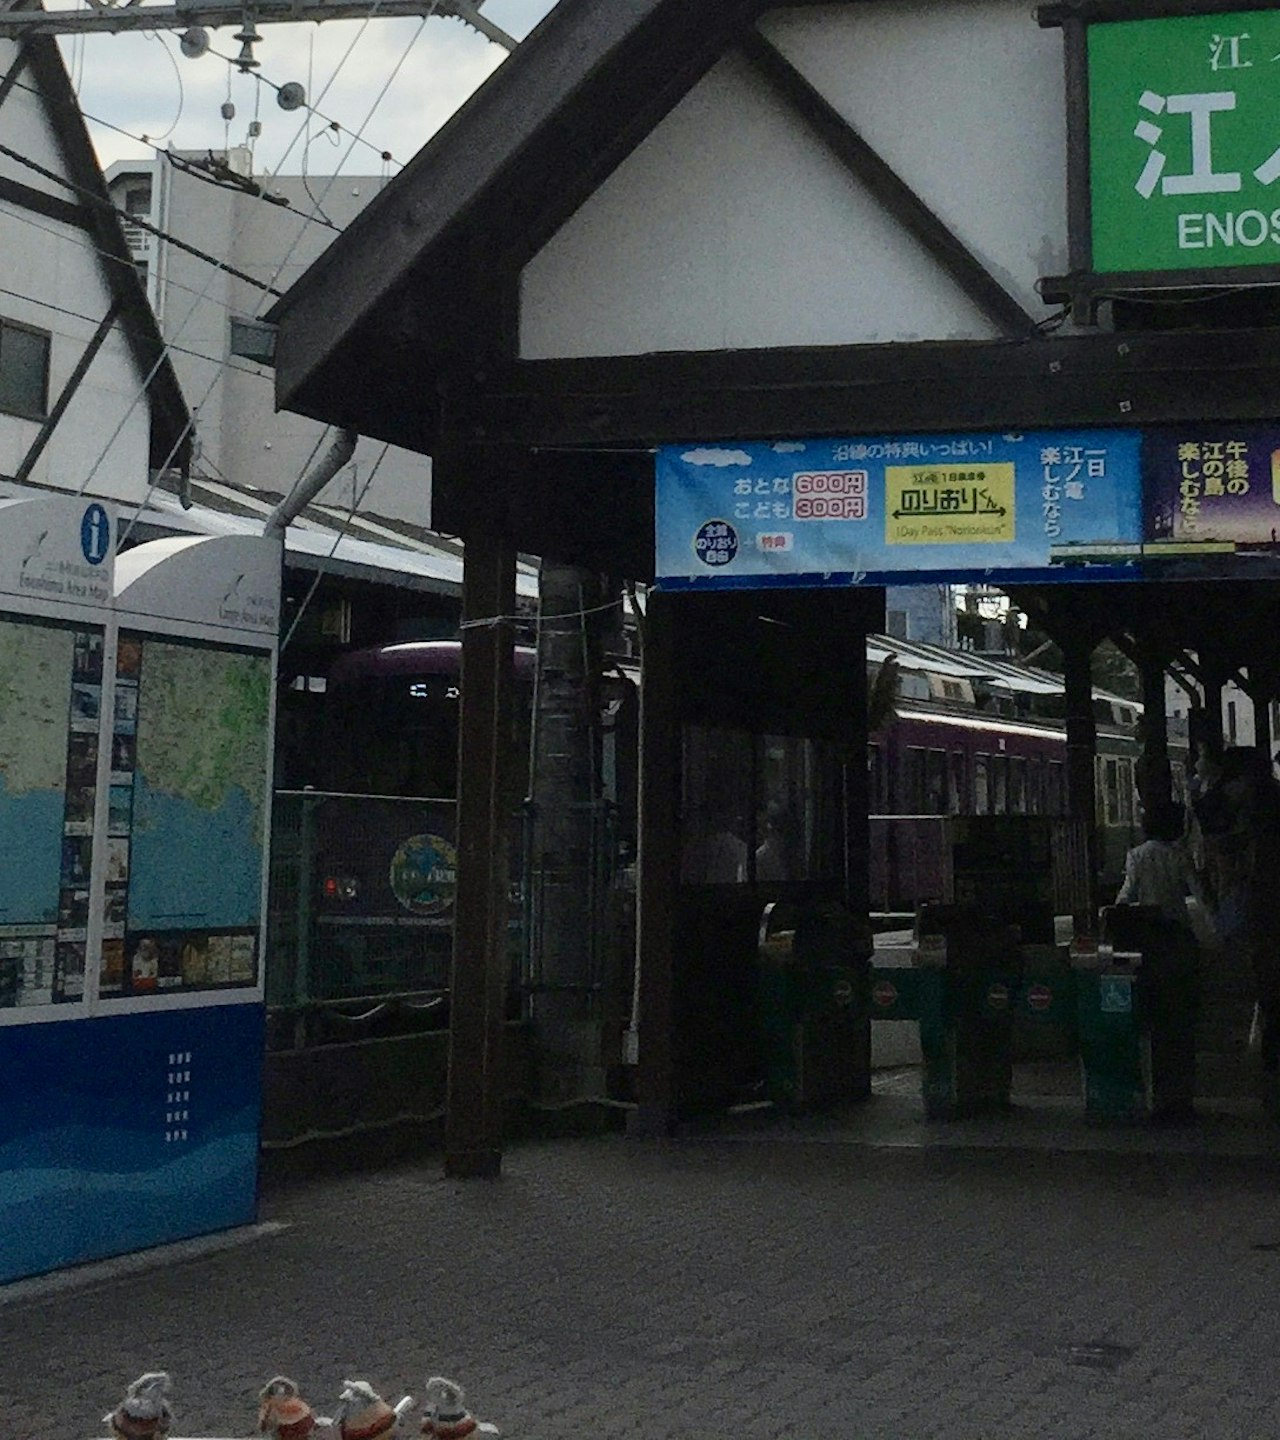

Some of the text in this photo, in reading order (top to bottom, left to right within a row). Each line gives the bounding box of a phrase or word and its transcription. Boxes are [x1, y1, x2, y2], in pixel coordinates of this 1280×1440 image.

[1084, 448, 1107, 477] 一日
[1202, 442, 1225, 496] 江の島
[1226, 441, 1250, 495] 午後の
[733, 472, 865, 495] おとな 600円
[1040, 447, 1062, 537] 楽しむなら
[733, 496, 865, 519] こども 300円
